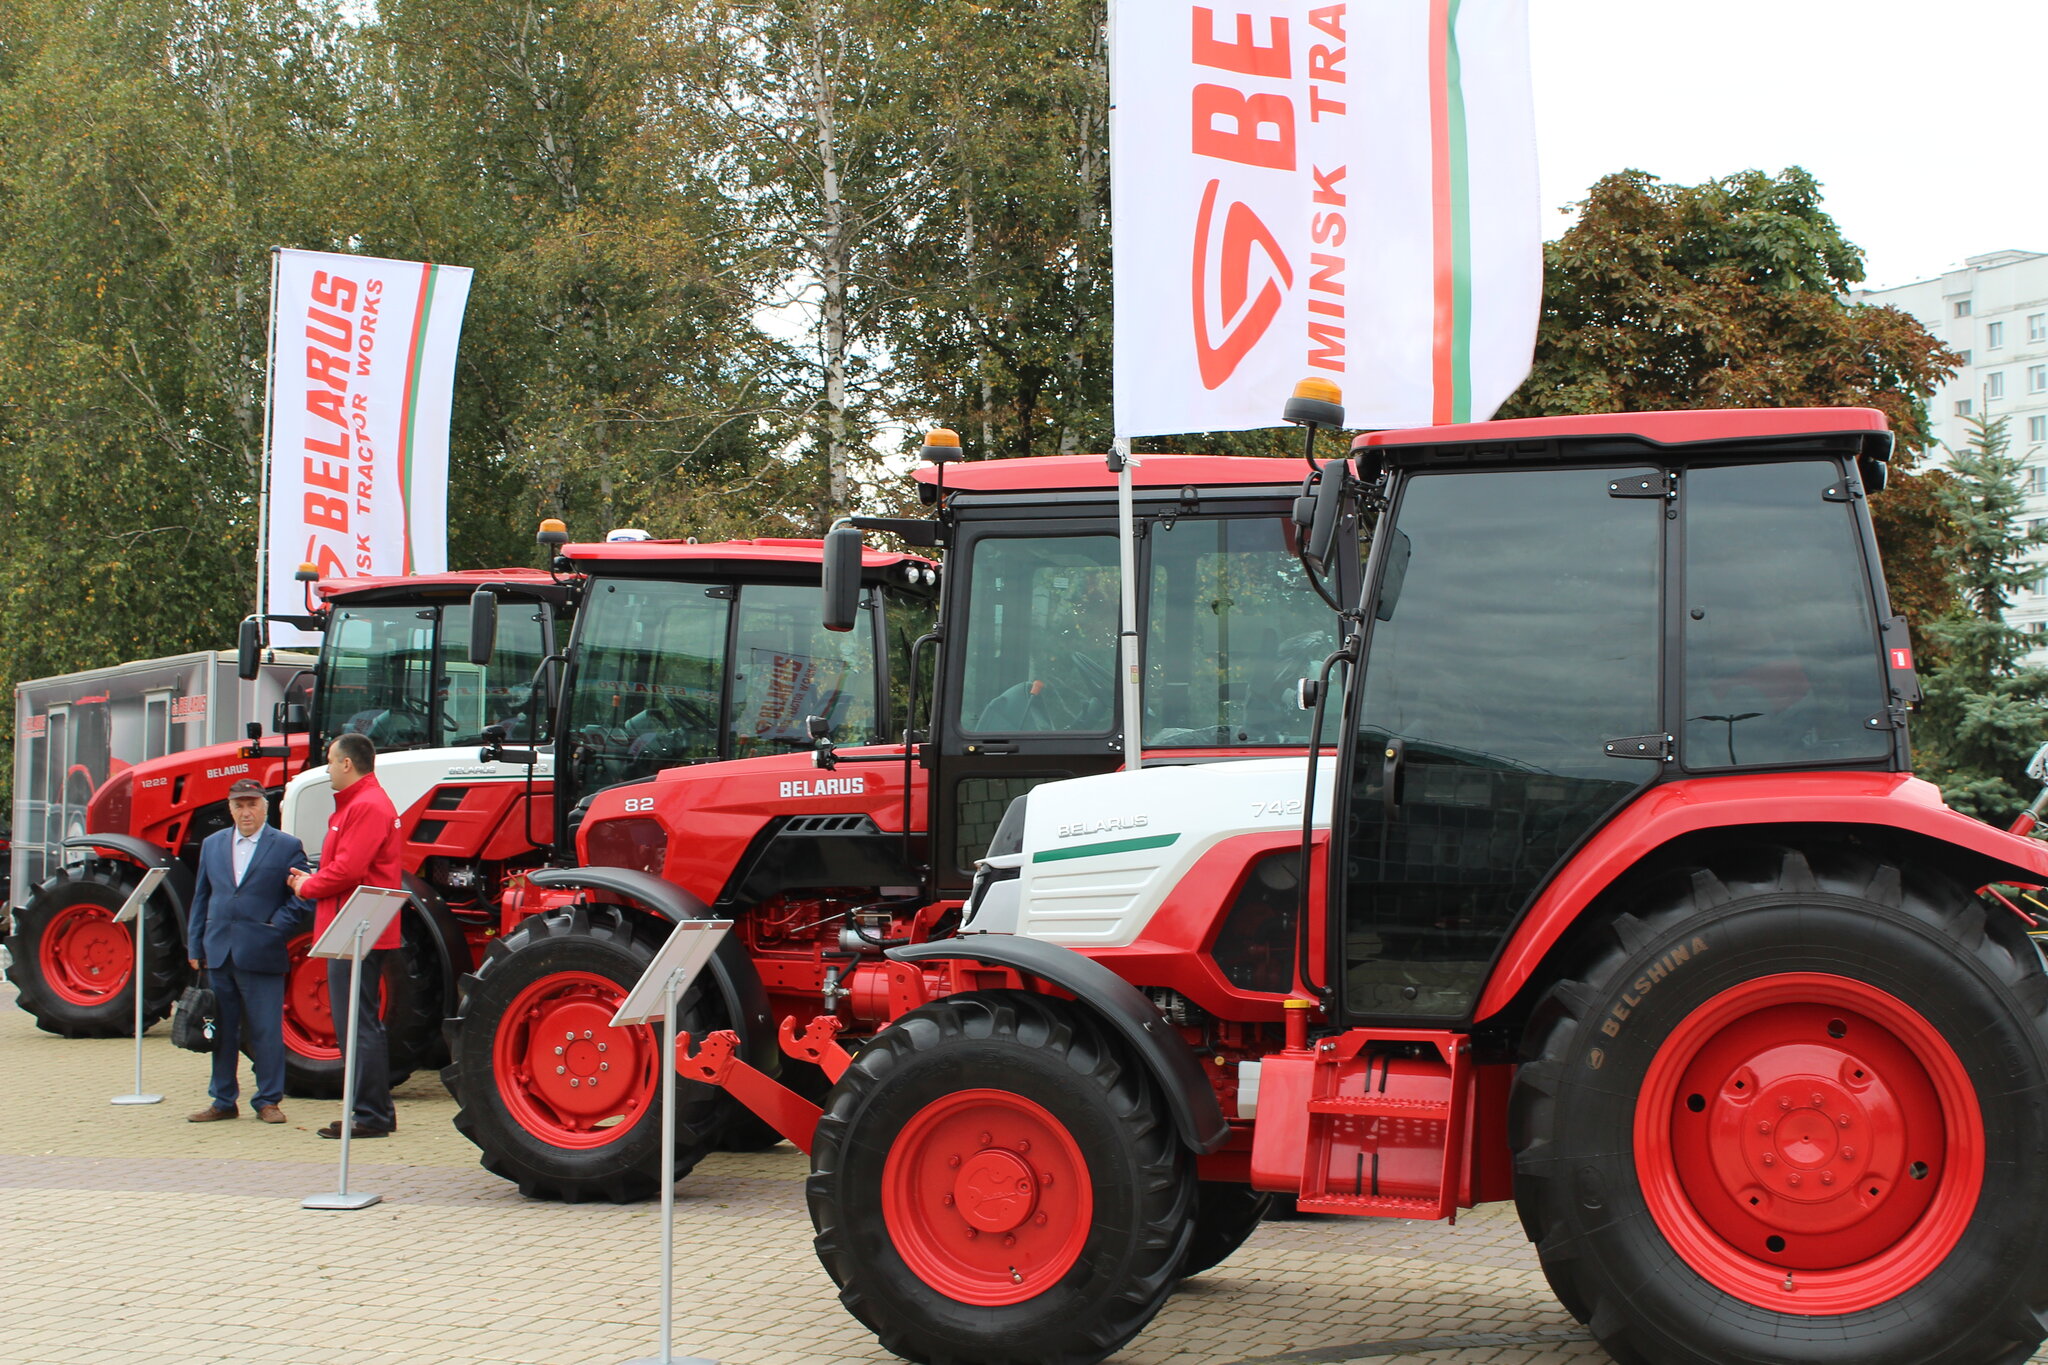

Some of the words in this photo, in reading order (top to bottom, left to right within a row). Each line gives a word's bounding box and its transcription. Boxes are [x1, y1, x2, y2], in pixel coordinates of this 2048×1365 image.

[1307, 164, 1347, 373] MINSK
[357, 279, 383, 376] WORKS
[303, 270, 357, 534] BELARUS
[352, 393, 374, 515] TRACTOR
[206, 763, 249, 779] BELARUS
[448, 765, 496, 775] BELARUS
[142, 777, 168, 788] 1222
[779, 777, 864, 798] BELARUS
[624, 797, 654, 812] 82
[1250, 799, 1302, 818] 742
[1057, 814, 1149, 838] BELARUS
[1601, 936, 1709, 1038] BELSHINA
